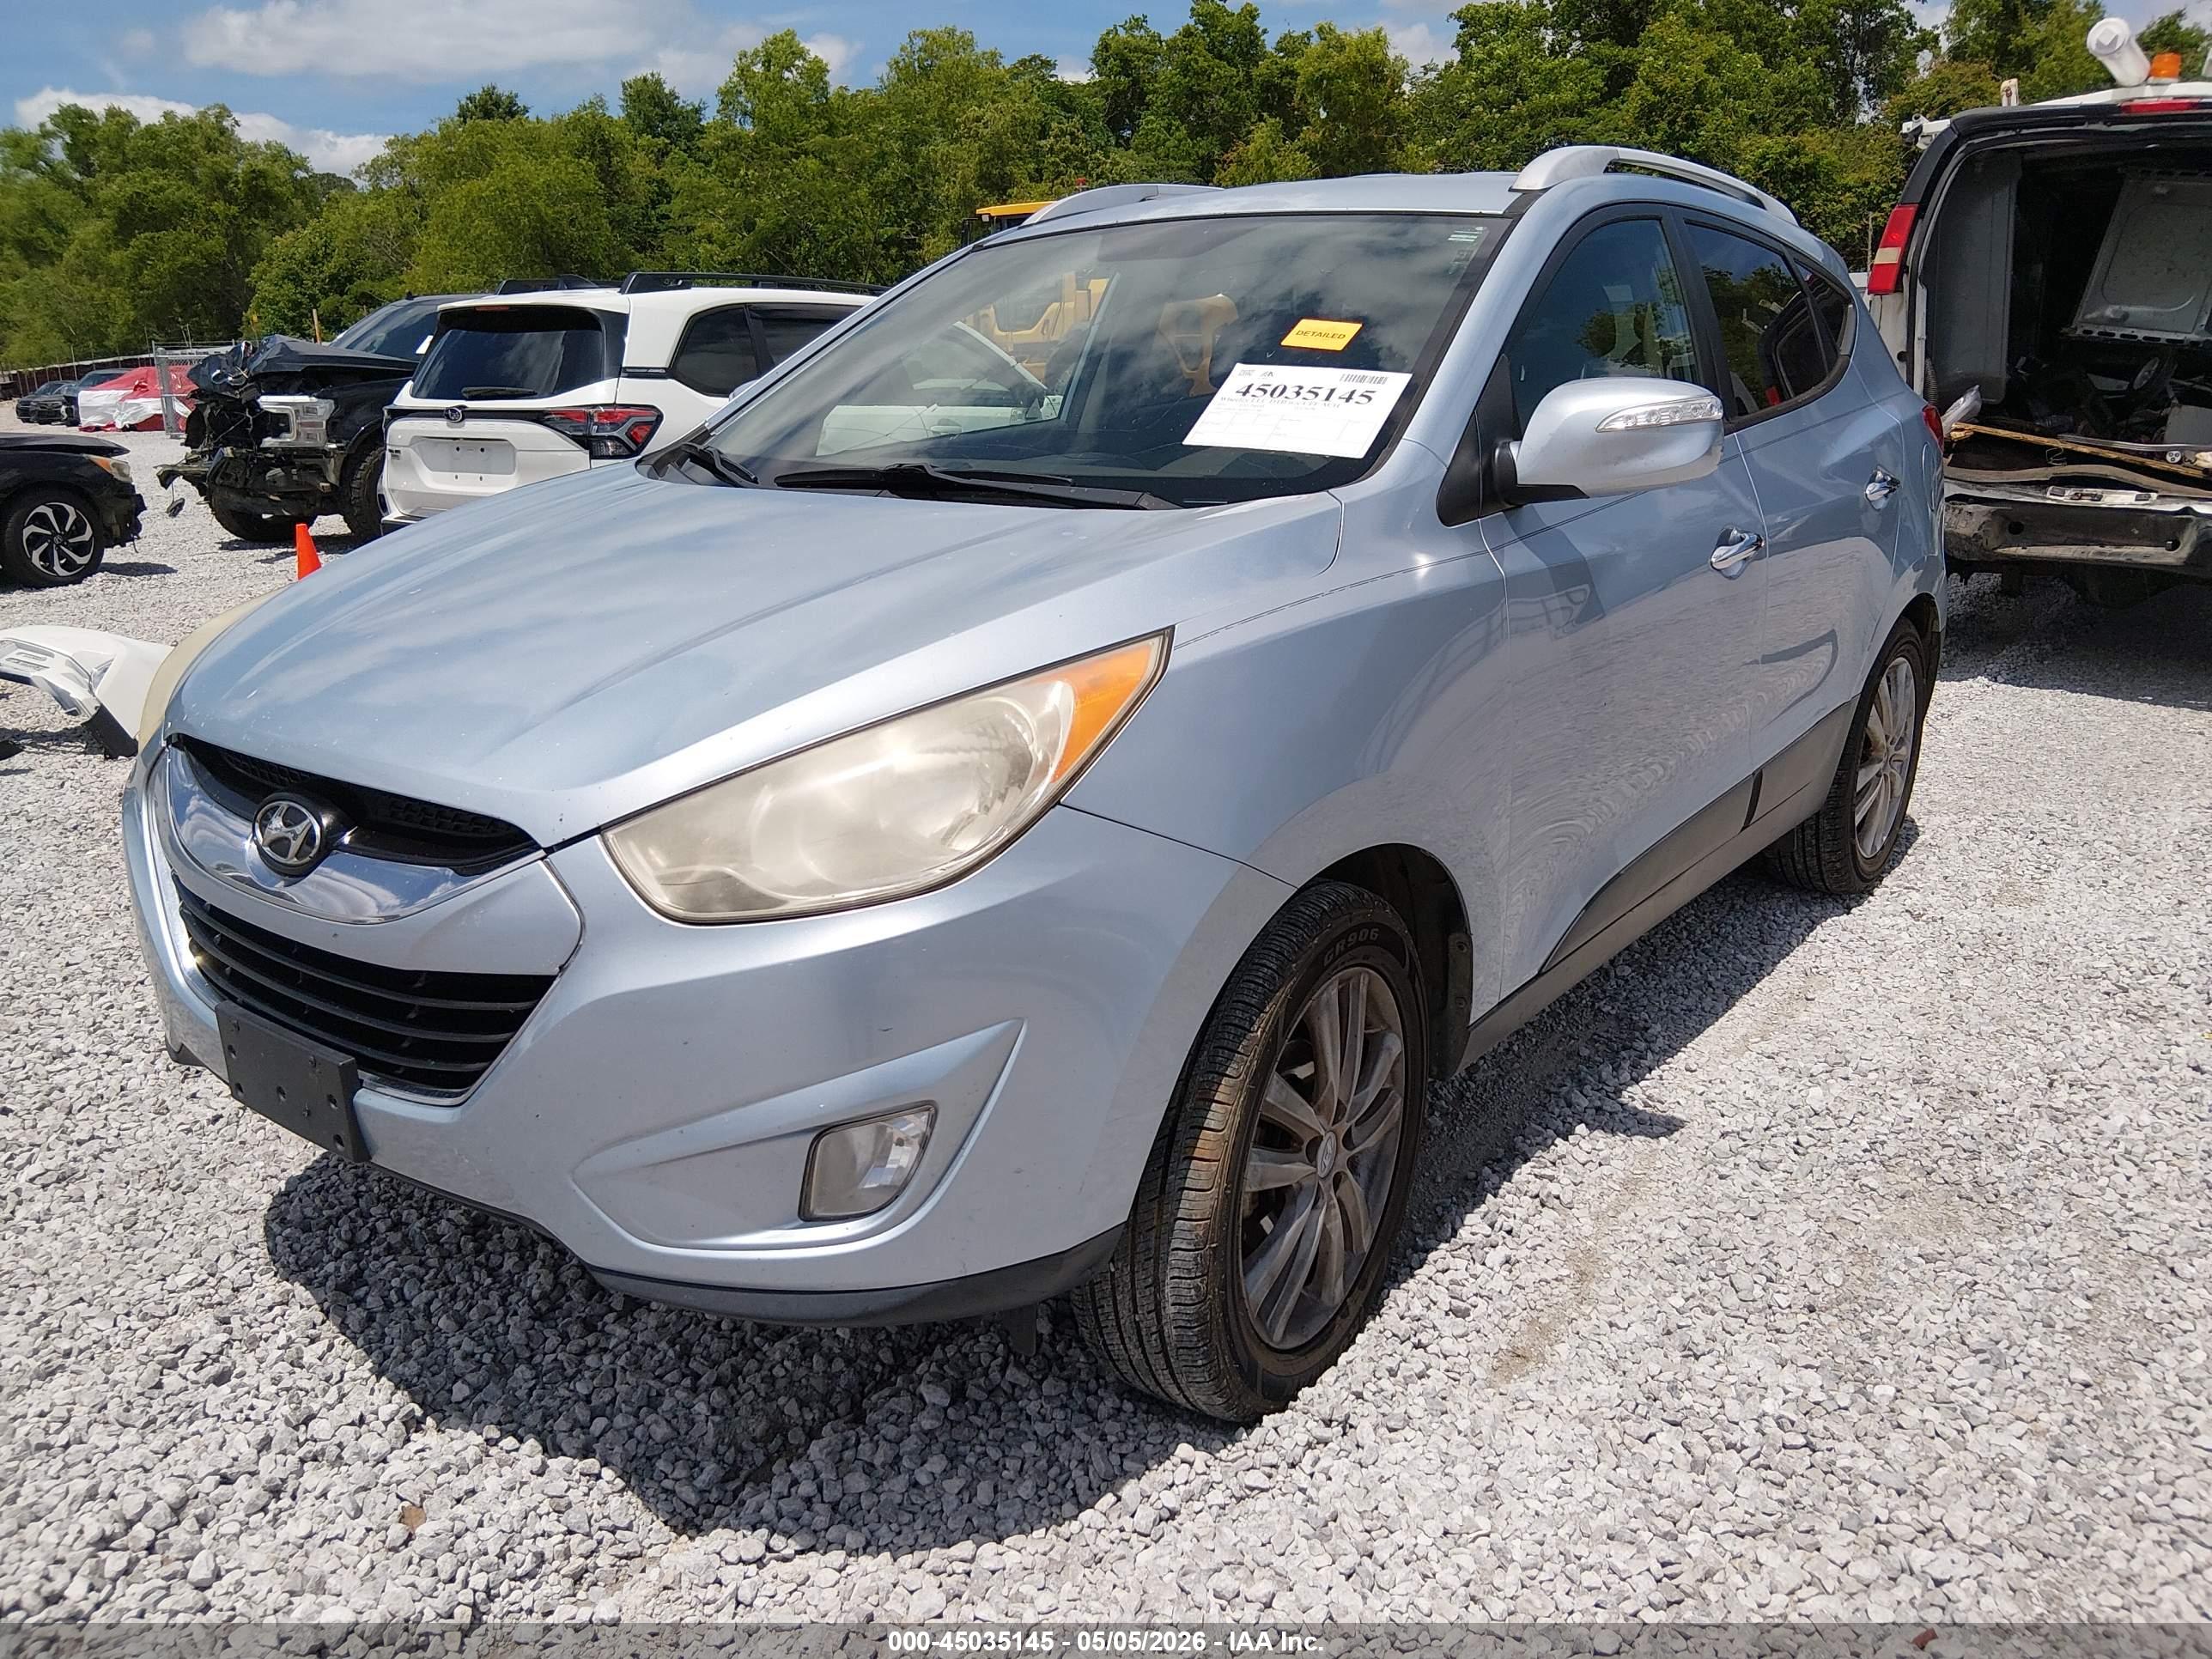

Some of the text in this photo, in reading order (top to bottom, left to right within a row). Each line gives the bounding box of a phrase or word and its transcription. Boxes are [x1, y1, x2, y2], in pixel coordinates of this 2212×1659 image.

[1296, 330, 1346, 339] DETAILED
[1235, 382, 1378, 405] 45035145
[1323, 928, 1380, 967] GR906
